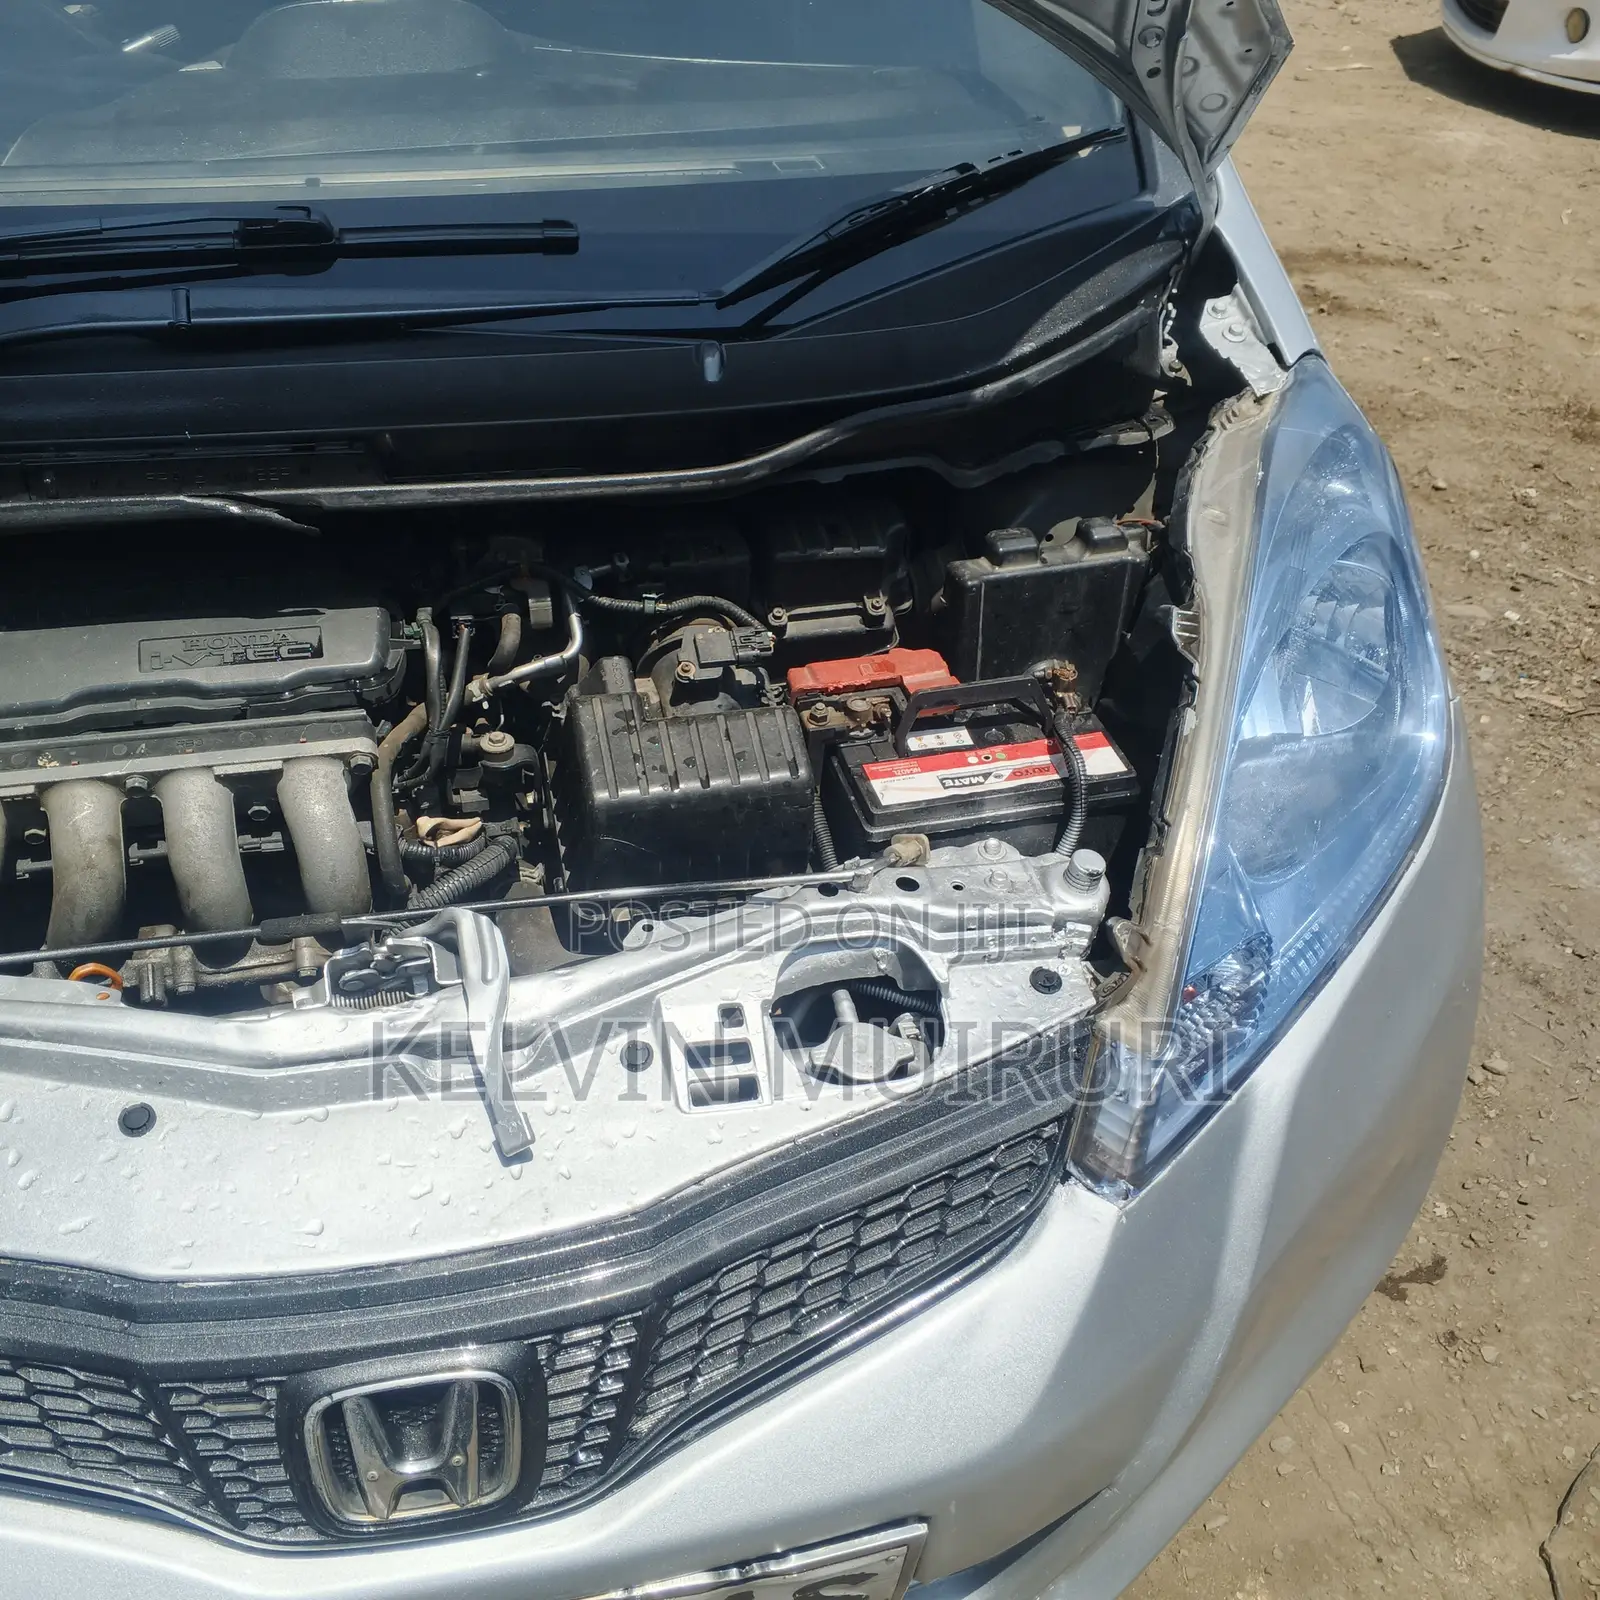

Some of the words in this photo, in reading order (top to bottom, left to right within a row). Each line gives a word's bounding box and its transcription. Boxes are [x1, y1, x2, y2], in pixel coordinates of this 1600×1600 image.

[182, 632, 298, 651] HONDA
[1012, 765, 1051, 778] AUTO
[942, 775, 985, 788] MATE
